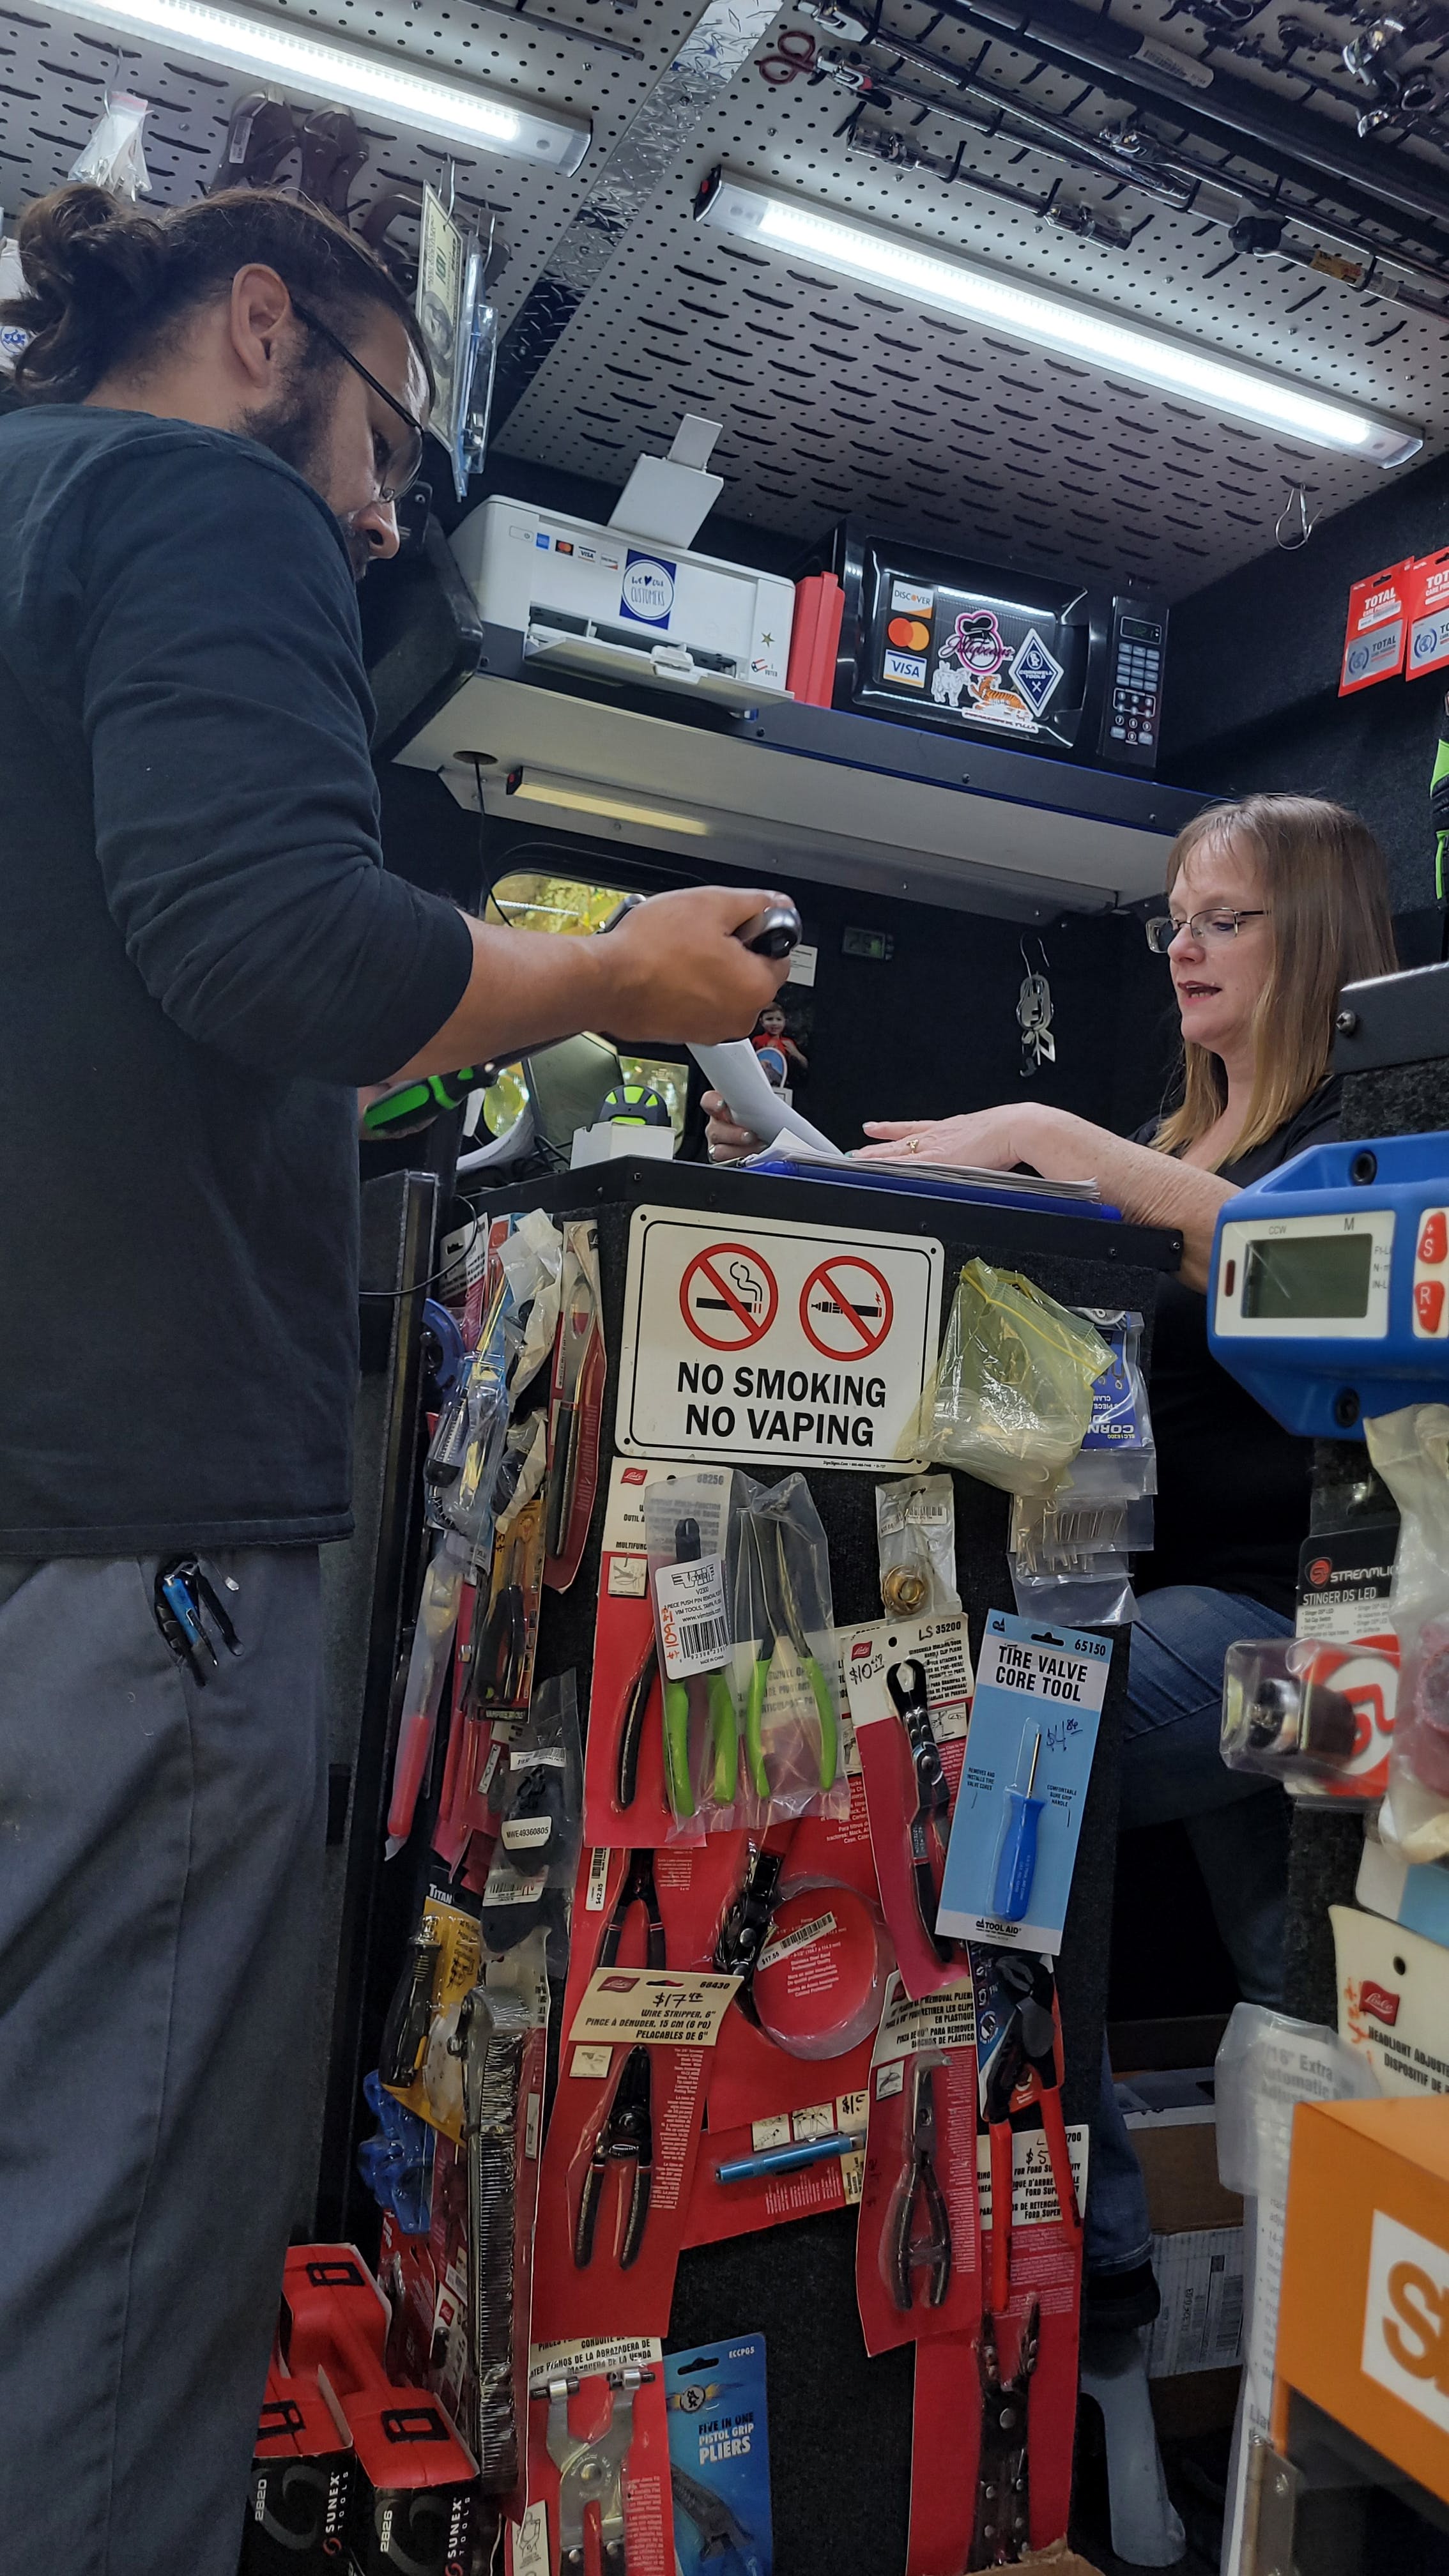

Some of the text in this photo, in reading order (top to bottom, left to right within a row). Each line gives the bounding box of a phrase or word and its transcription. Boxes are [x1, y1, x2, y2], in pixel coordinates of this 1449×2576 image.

[894, 589, 931, 606] DISCOVER
[1365, 586, 1396, 610] TOTAL
[1372, 635, 1396, 652] TOTAL
[891, 659, 920, 678] VISA
[1268, 1218, 1355, 1235] CCW M
[1423, 1239, 1434, 1257] S
[1420, 1287, 1430, 1305] R
[678, 1361, 887, 1407] NO SMOKING
[686, 1404, 874, 1447] NO VAPING
[624, 1514, 639, 1522] OUTIL
[1303, 1586, 1376, 1606] STINGER DS LED
[935, 1621, 962, 1635] 35200
[1074, 1639, 1107, 1657] 65150
[999, 1644, 1088, 1683] TIRE VALVE
[950, 1689, 968, 1697] PUERTAS
[995, 1666, 1081, 1703] CORE TOOL
[969, 1767, 986, 1776] REMOVES
[1046, 1784, 1077, 1796] COMFORTABLE
[429, 1883, 452, 1905] TITAN
[985, 1921, 1005, 1932] TOOL
[641, 2009, 662, 2018] WIRE
[935, 2011, 974, 2024] EN PLASTIQUE
[946, 2005, 956, 2013] LES
[585, 2017, 609, 2026] PINCE
[671, 2020, 684, 2028] CM
[930, 2027, 946, 2036] PARA
[947, 2023, 975, 2034] REMOVER
[636, 2029, 684, 2041] PELACABLES
[685, 2032, 696, 2041] DE
[947, 2032, 975, 2044] PLÁSTICO
[1368, 2025, 1411, 2058] HEADLIGHT
[1300, 2054, 1333, 2082] Extra
[1384, 2052, 1429, 2087] DISPOSITIF
[1014, 2167, 1026, 2176] FOR
[1027, 2165, 1043, 2174] FORD
[1025, 2188, 1041, 2196] FORD
[1024, 2211, 1041, 2220] FORD
[574, 2338, 650, 2364] DE LA ABRAZADERA DE
[618, 2356, 627, 2364] LA
[698, 2412, 755, 2435] FIVE IN ONE
[698, 2423, 755, 2447] PISTOL GRIP
[698, 2435, 752, 2465] PLIERS
[255, 2478, 268, 2522] 2820
[325, 2474, 341, 2534] SUNEX
[337, 2471, 349, 2531] TOOLS
[380, 2510, 394, 2553] 2826
[448, 2499, 463, 2559] SUNEX
[459, 2496, 471, 2556] TOOLS
